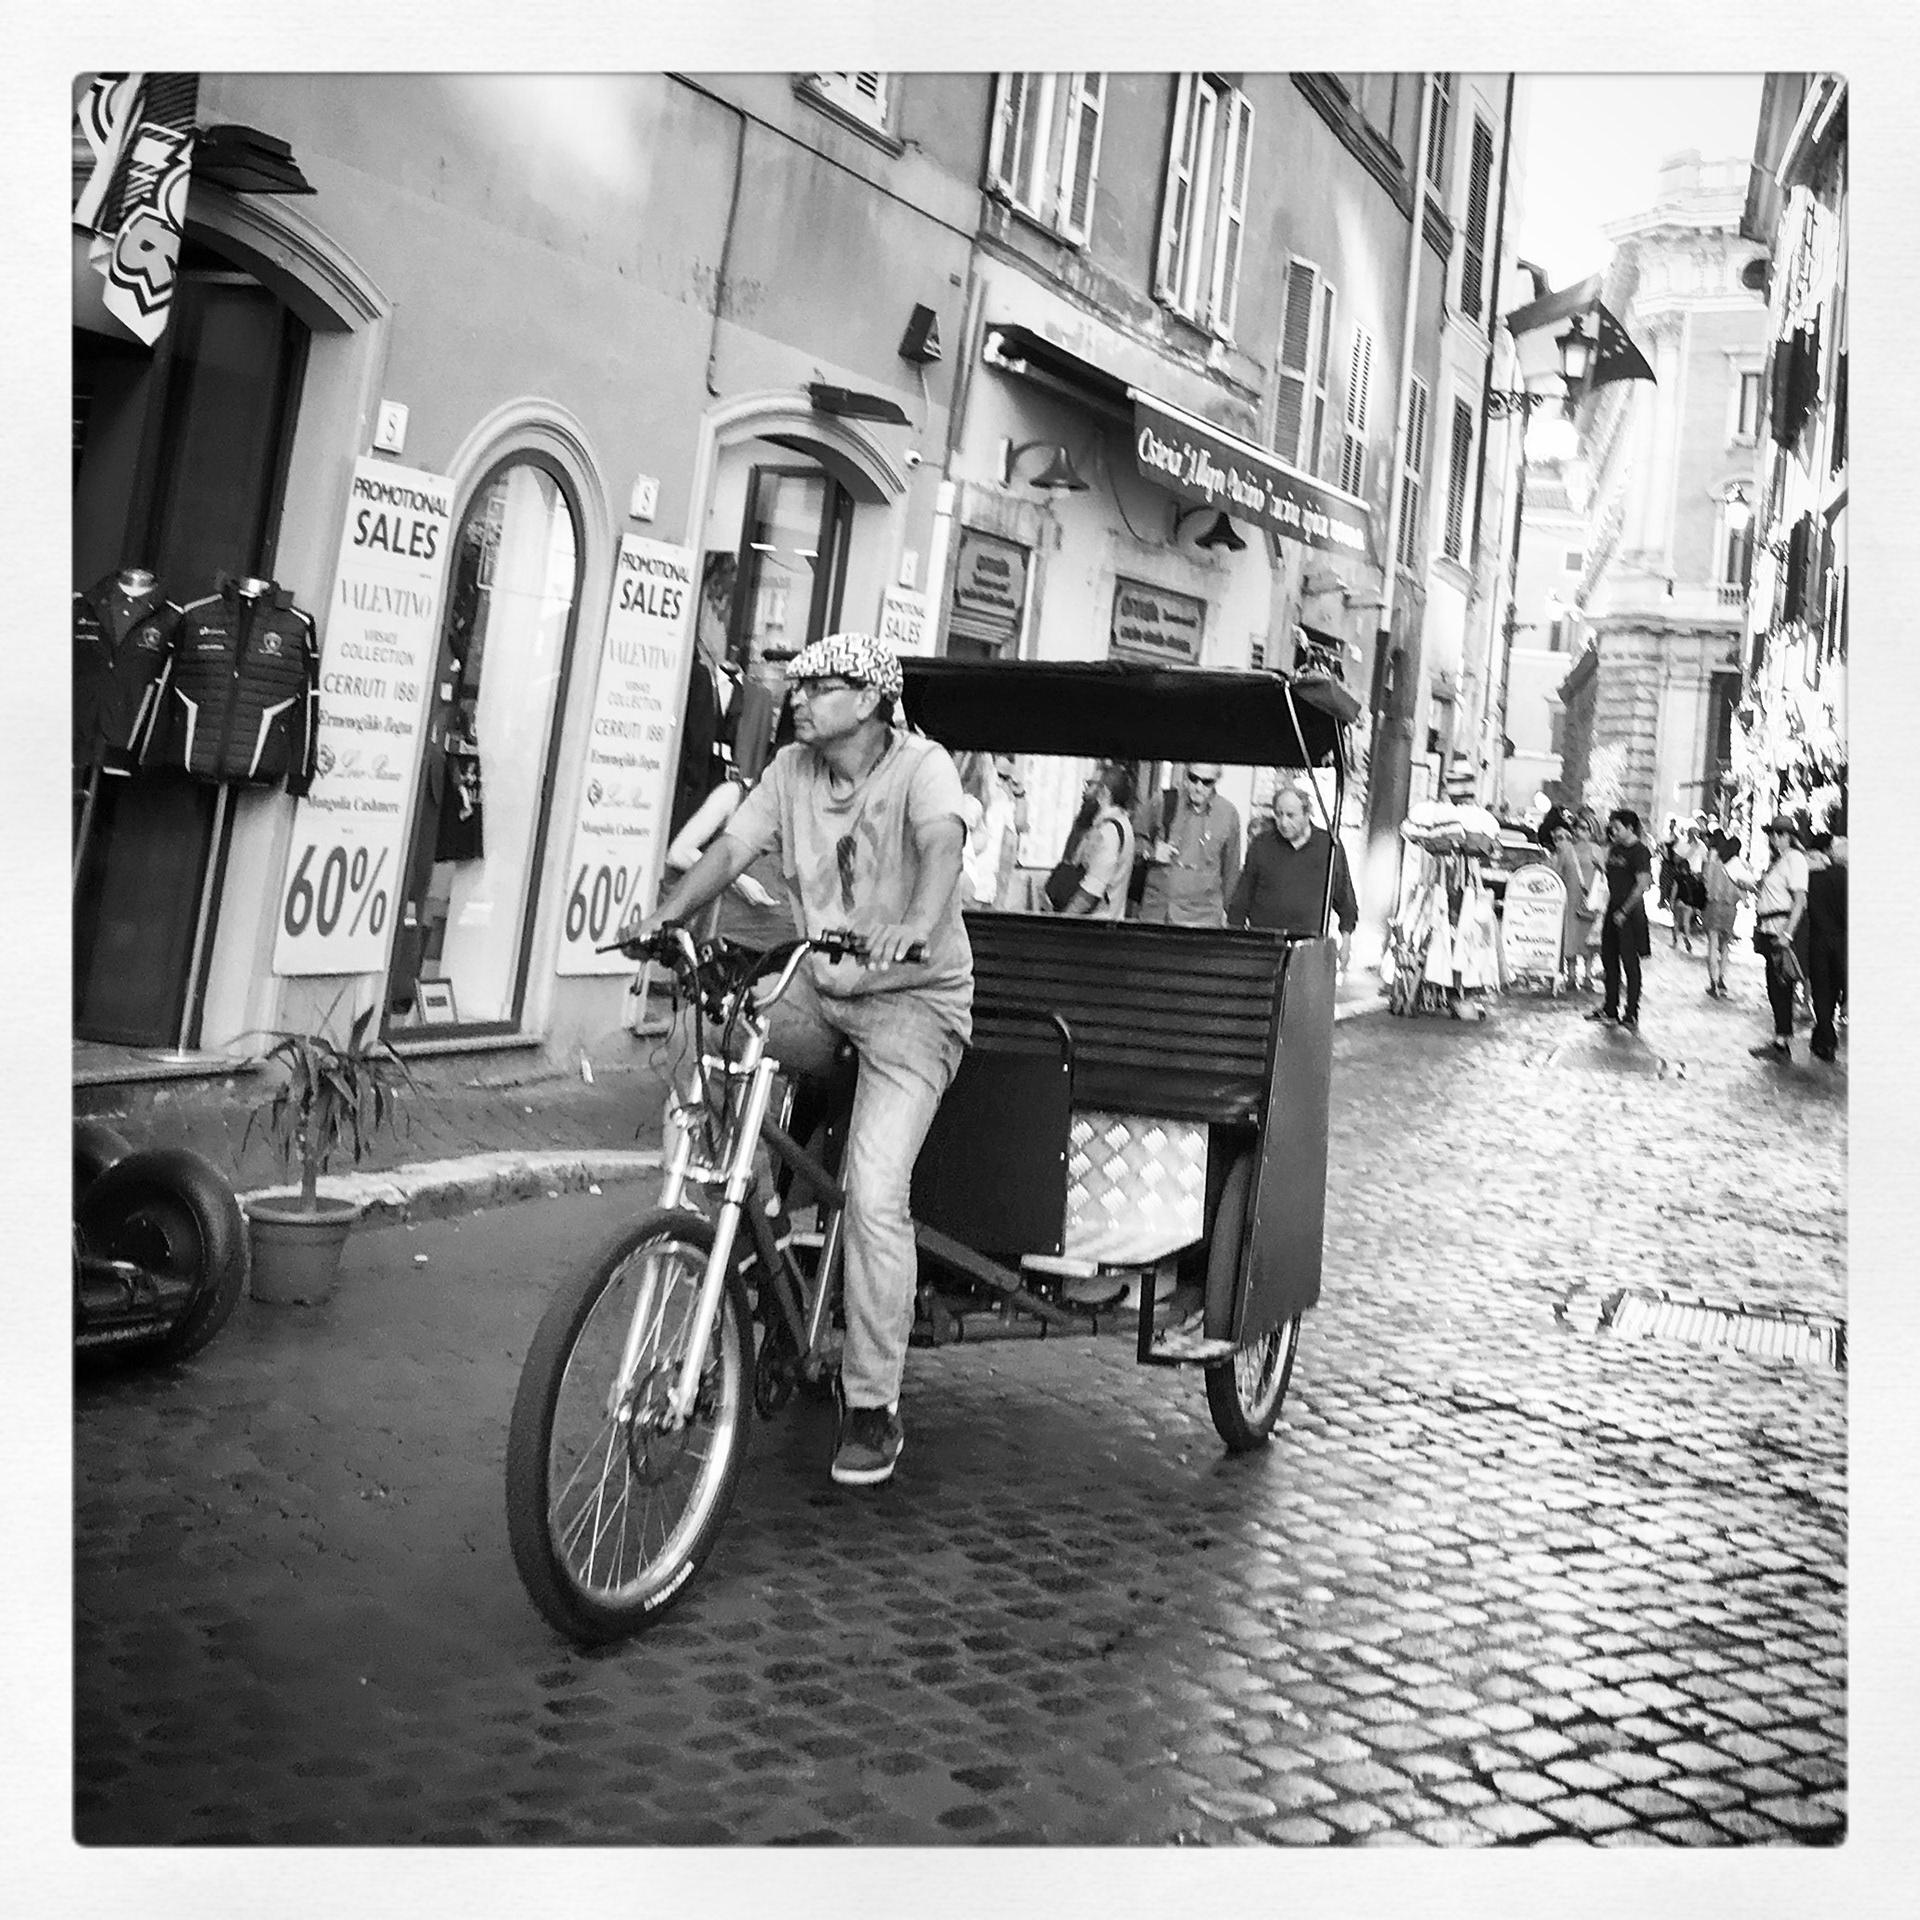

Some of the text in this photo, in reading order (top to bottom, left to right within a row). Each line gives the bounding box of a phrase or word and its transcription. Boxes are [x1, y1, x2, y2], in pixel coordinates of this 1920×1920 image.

[352, 477, 449, 519] PROMOTIONAL
[353, 508, 439, 560] SALES
[620, 552, 692, 585] PROMOTIONAL
[619, 578, 683, 620] SALES
[884, 616, 922, 645] SALES
[339, 642, 416, 667] COLLECTION
[323, 672, 388, 699] CERRUTI
[595, 718, 642, 740] CERRUTI
[284, 844, 389, 938] 60%
[565, 863, 643, 943] 60%
